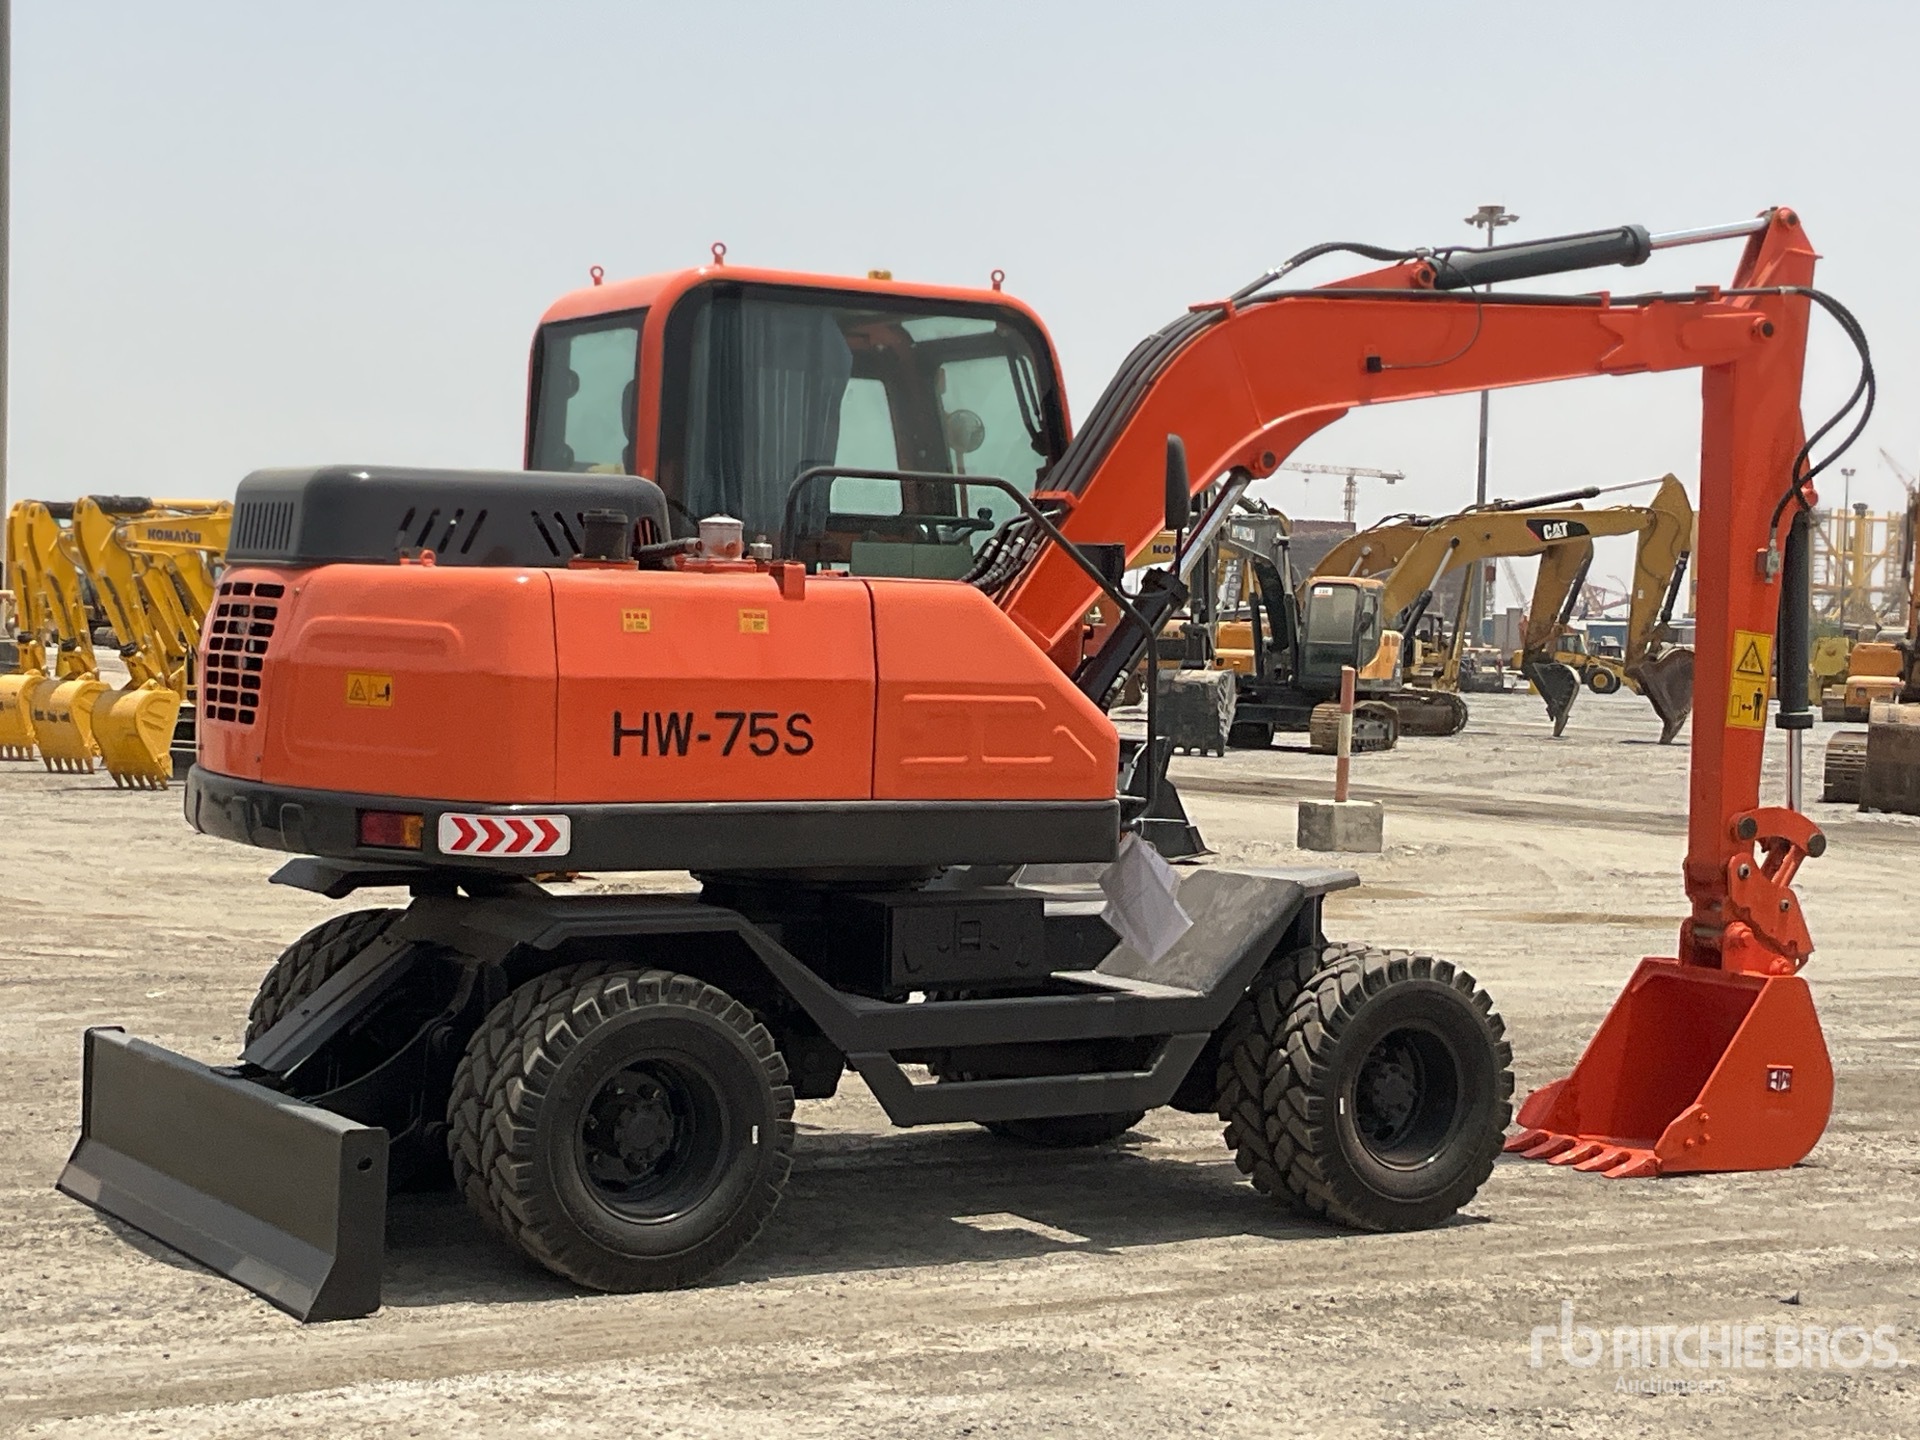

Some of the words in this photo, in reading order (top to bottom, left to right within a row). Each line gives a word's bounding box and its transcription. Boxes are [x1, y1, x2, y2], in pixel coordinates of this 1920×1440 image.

[147, 529, 201, 544] KOMATSU
[1543, 521, 1568, 540] CAT
[612, 711, 814, 757] HW-75S
